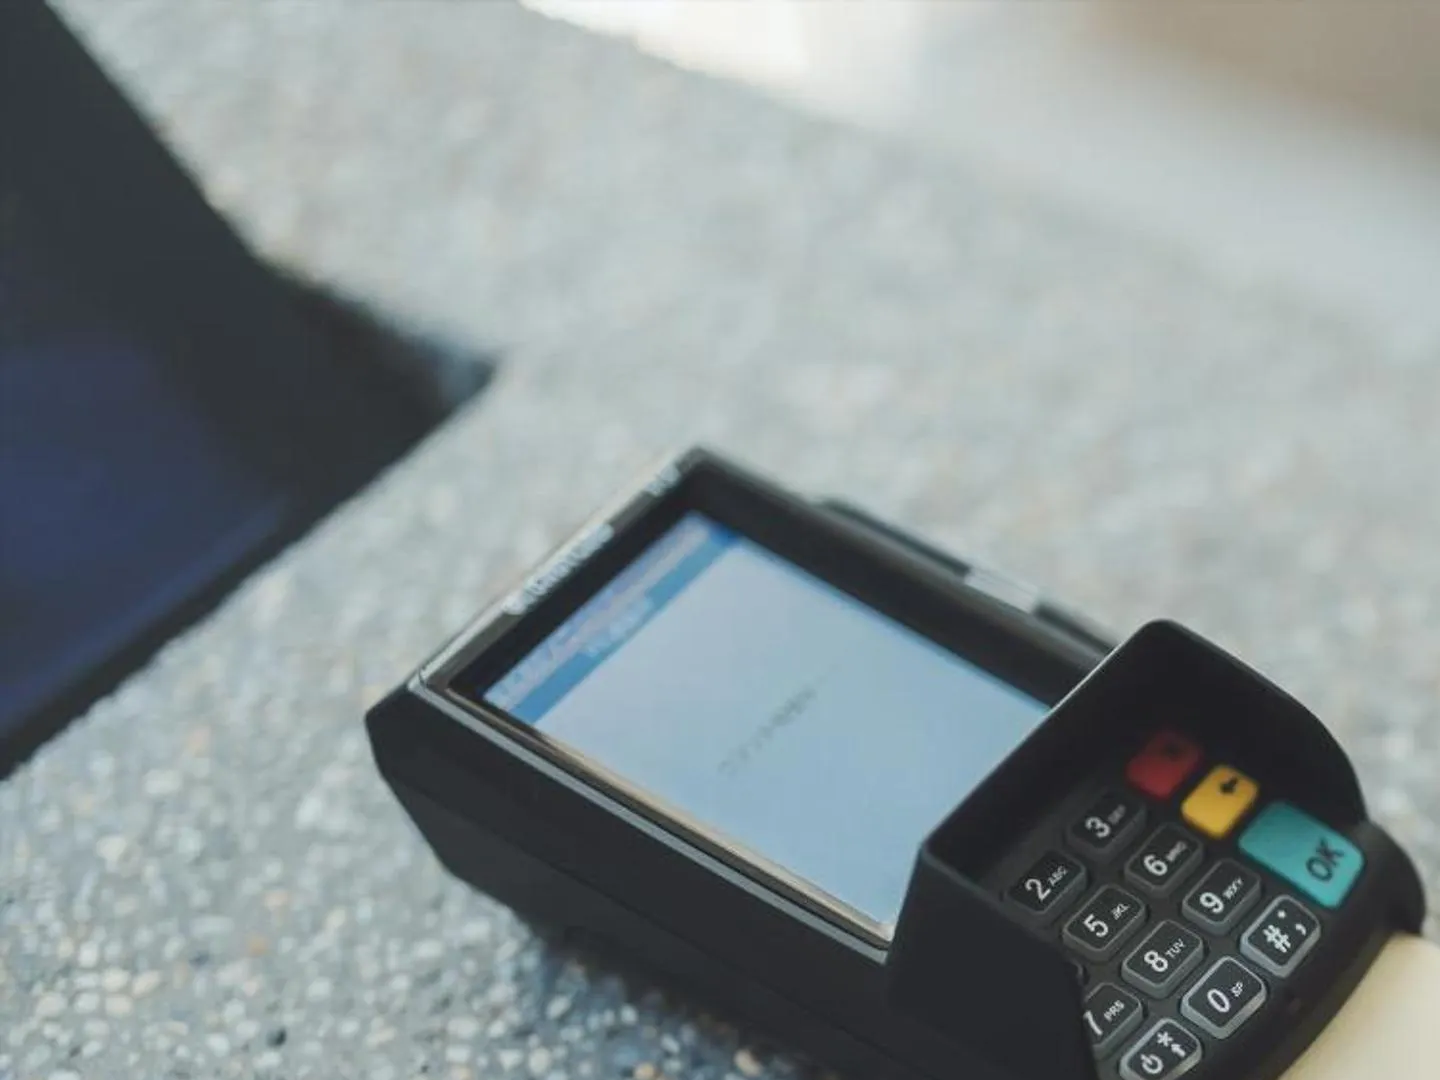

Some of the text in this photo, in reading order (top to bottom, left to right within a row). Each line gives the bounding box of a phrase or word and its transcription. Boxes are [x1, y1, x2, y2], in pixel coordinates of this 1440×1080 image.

[1084, 814, 1111, 839] 3
[1143, 853, 1168, 877] 6
[1305, 837, 1345, 883] OK
[1024, 865, 1069, 902] 2 ABC
[1199, 891, 1225, 914] 9
[1083, 914, 1109, 938] 5
[1143, 938, 1186, 973] 8 TUV
[1103, 999, 1126, 1022] PRS
[1206, 988, 1231, 1013] 0
